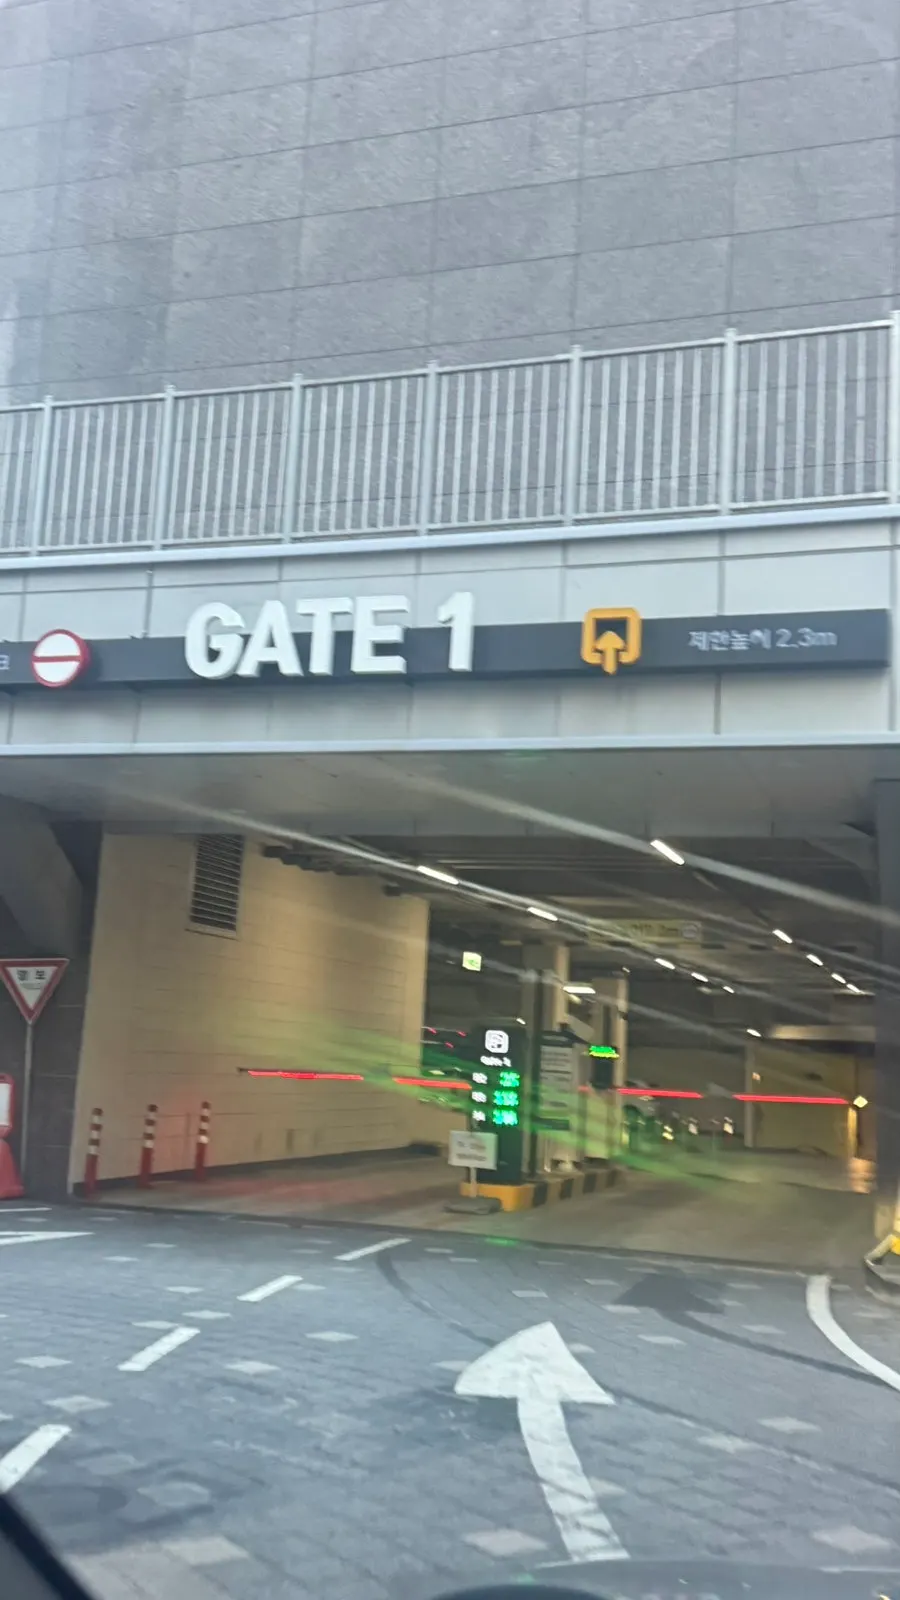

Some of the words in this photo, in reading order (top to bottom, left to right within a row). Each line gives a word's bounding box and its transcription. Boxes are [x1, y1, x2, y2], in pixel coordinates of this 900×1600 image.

[184, 594, 410, 679] GATE
[437, 591, 475, 672] 1
[688, 629, 772, 651] 제한높이
[775, 627, 838, 649] 2.3m
